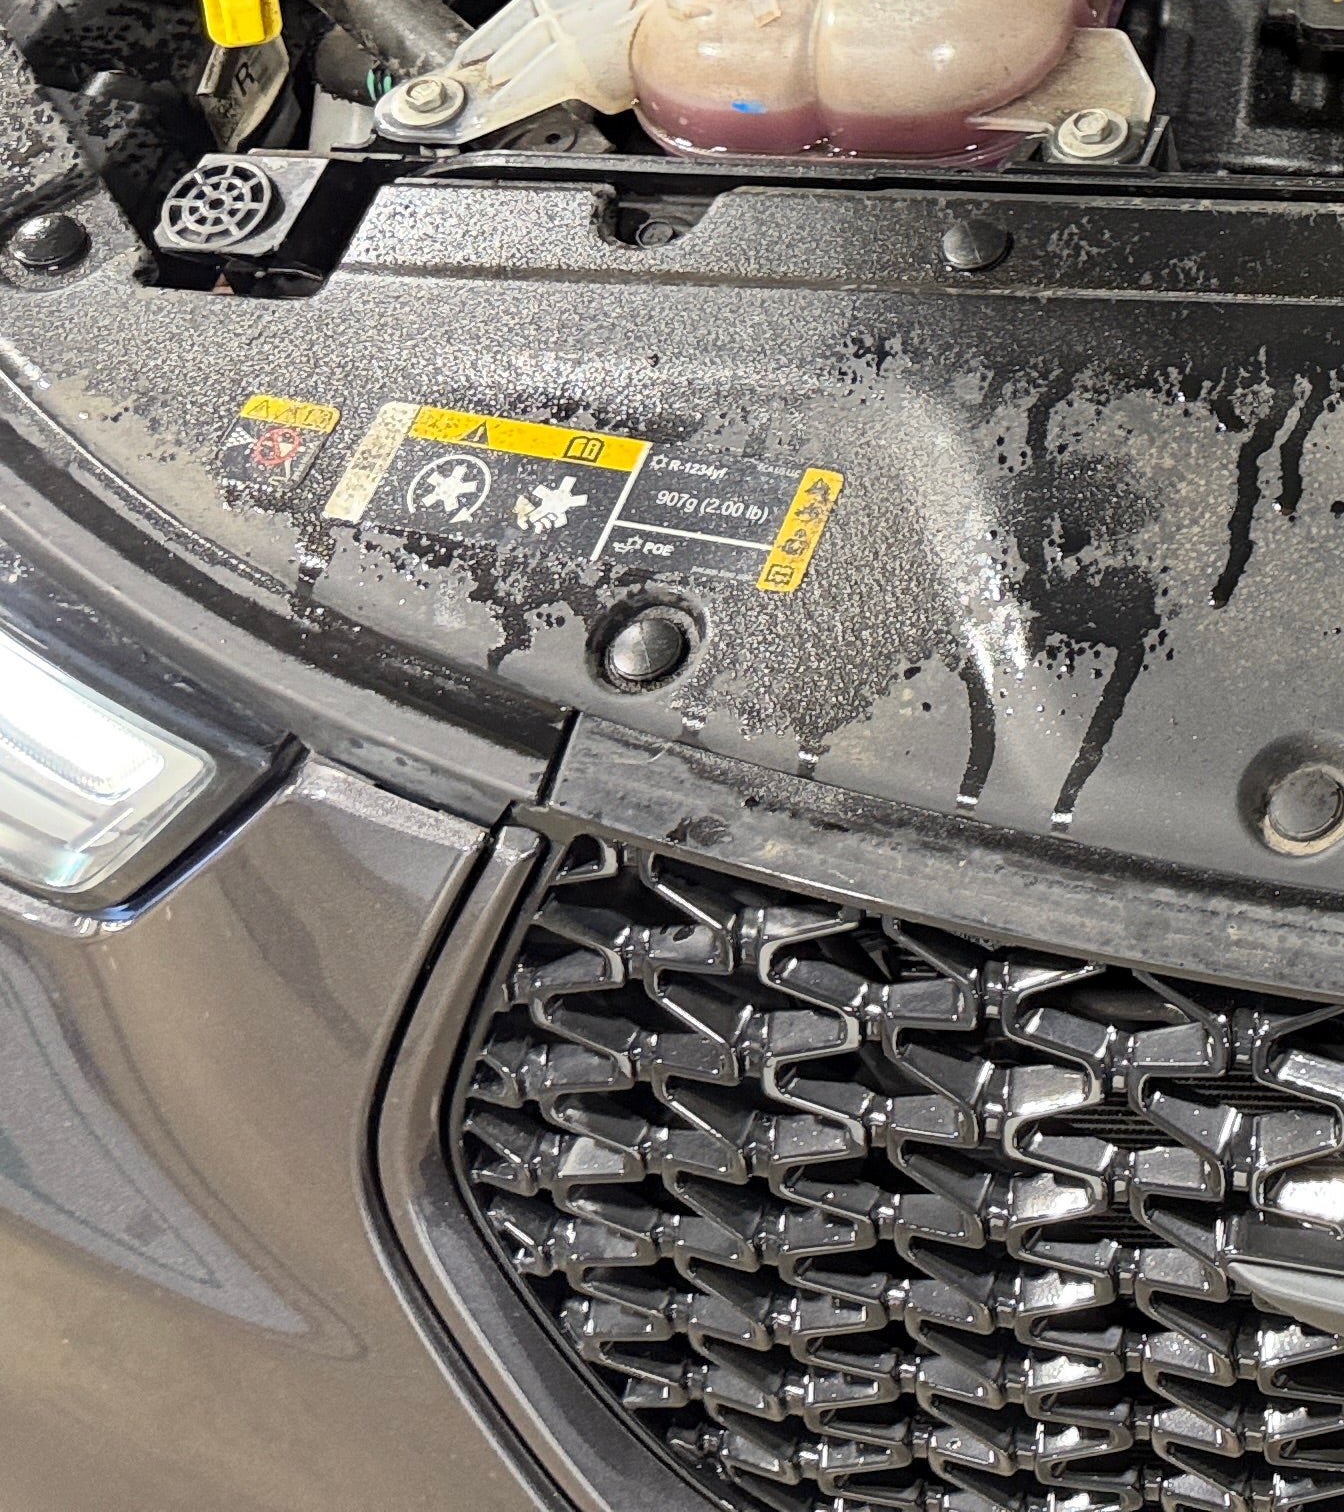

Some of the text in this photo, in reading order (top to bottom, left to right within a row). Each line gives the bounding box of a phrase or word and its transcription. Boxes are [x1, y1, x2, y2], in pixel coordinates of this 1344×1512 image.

[667, 459, 728, 480] R-1234yf
[655, 489, 769, 524] 907g (2.00 lb)
[642, 541, 675, 557] POE
